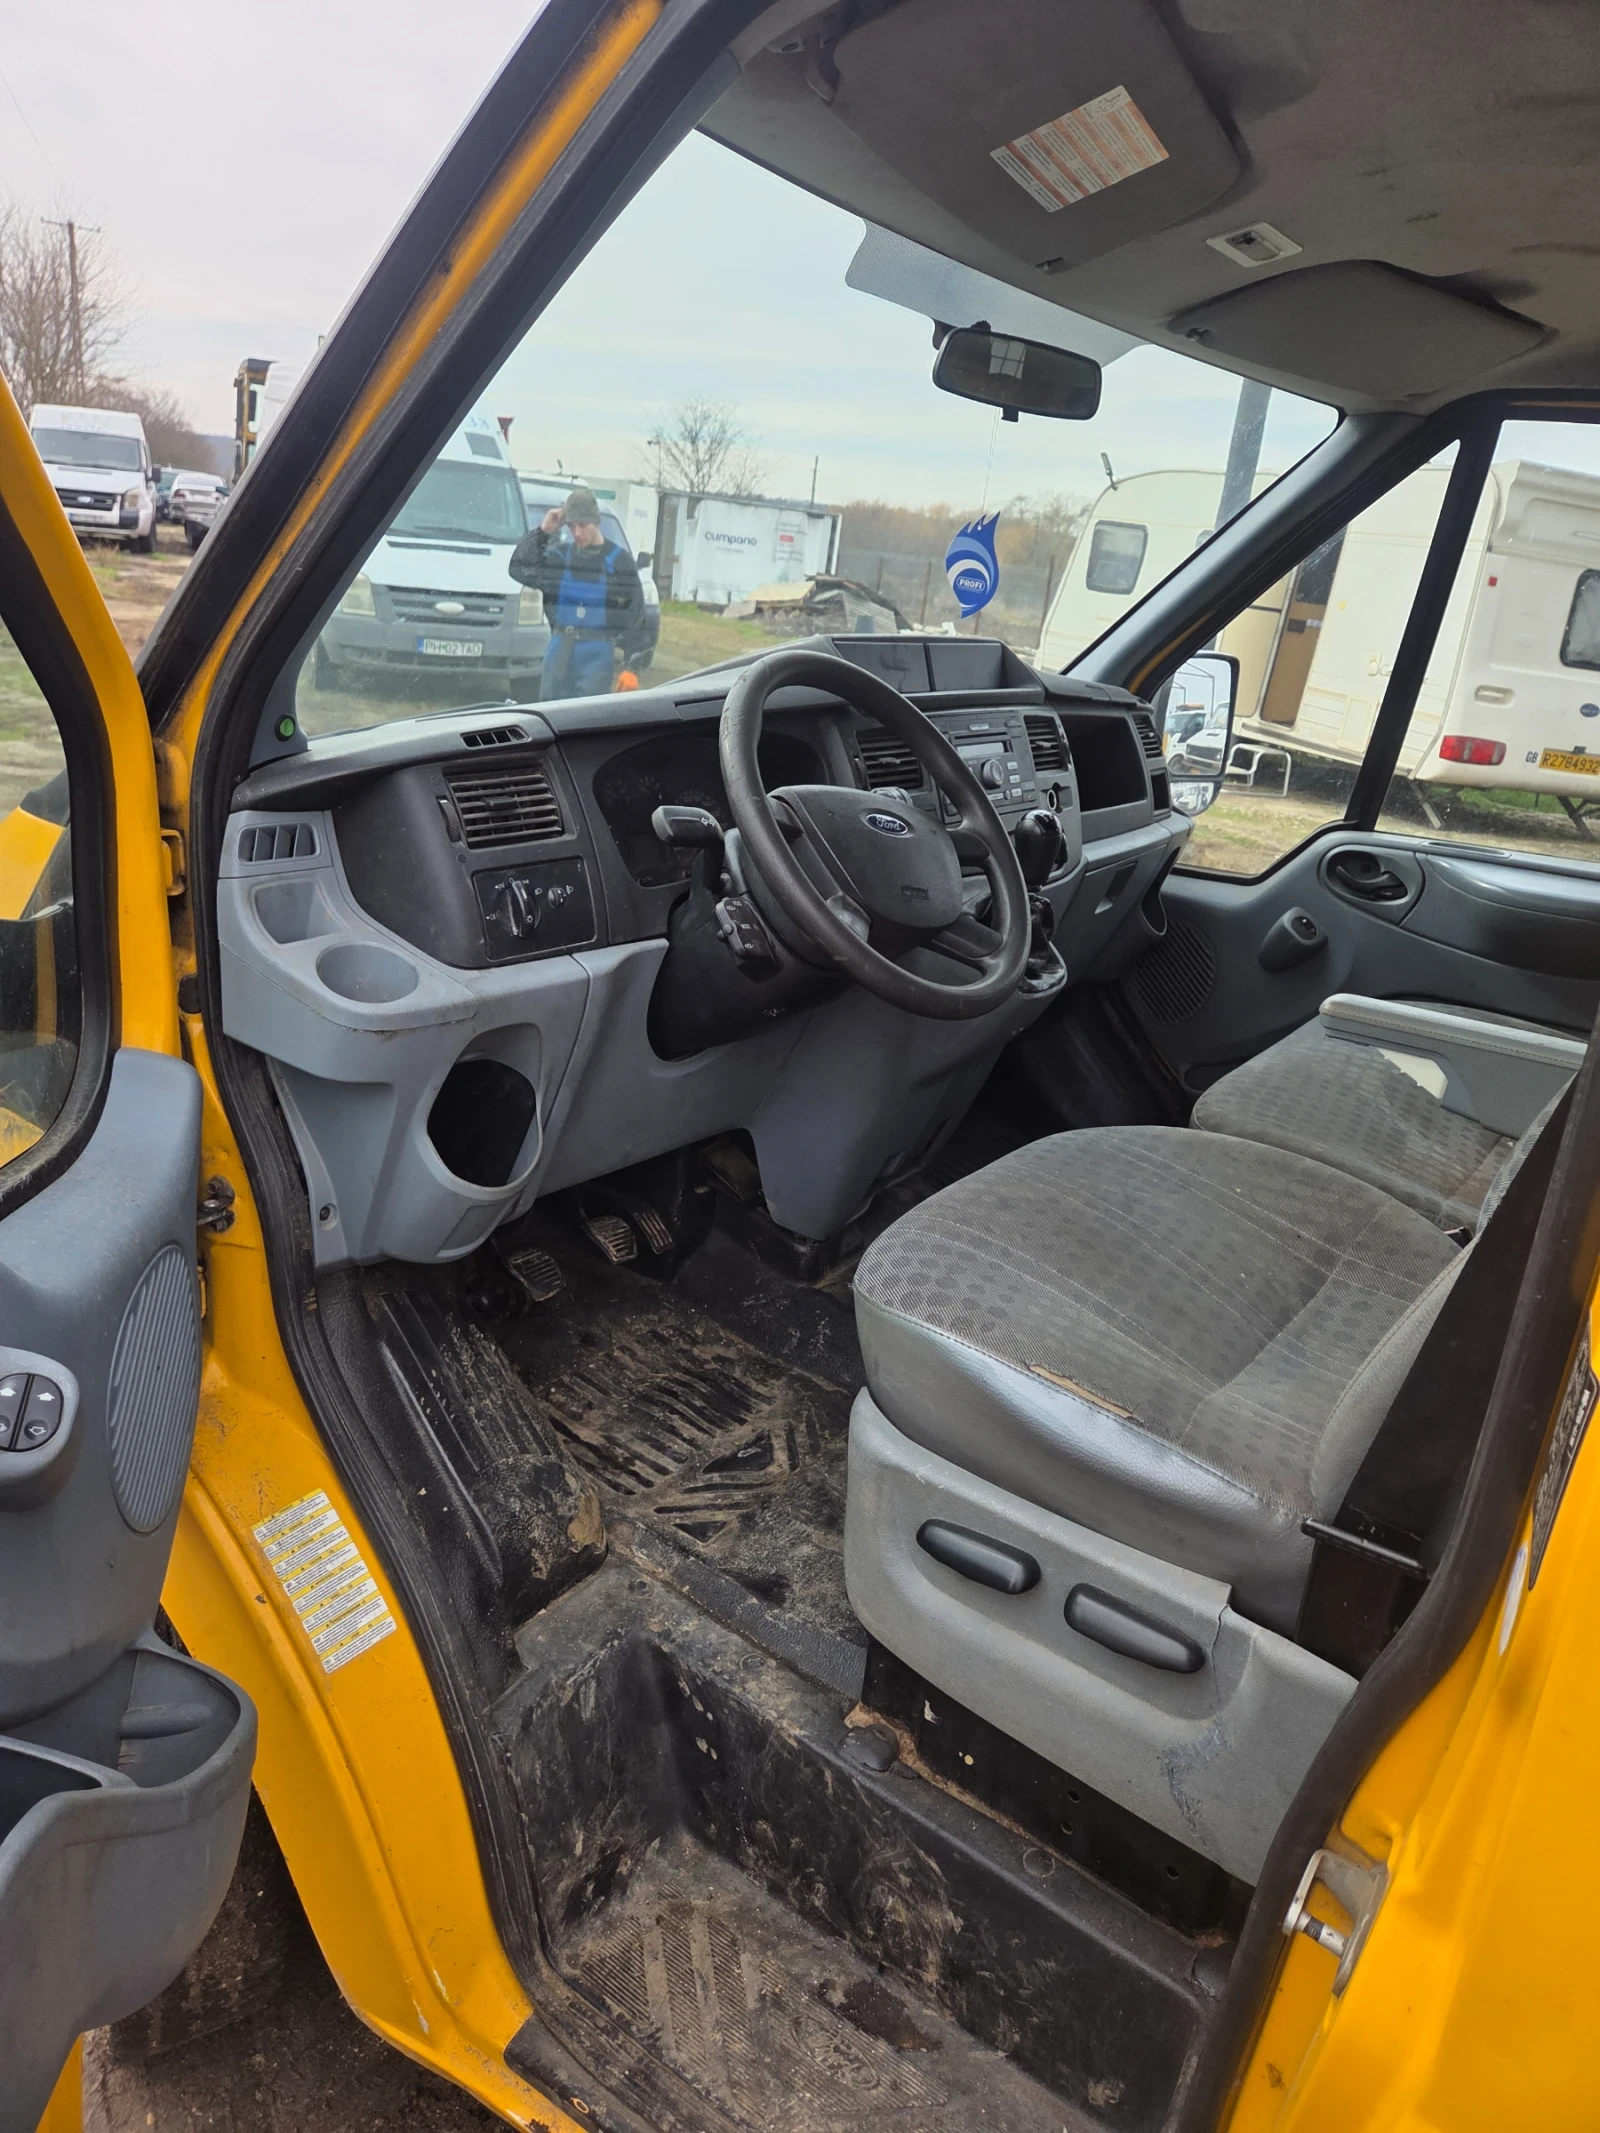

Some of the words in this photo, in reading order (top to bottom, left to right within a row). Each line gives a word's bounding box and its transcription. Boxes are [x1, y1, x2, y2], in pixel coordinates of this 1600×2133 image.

[959, 578, 982, 589] PROFI
[1525, 750, 1539, 763] GB
[876, 816, 901, 831] Ford
